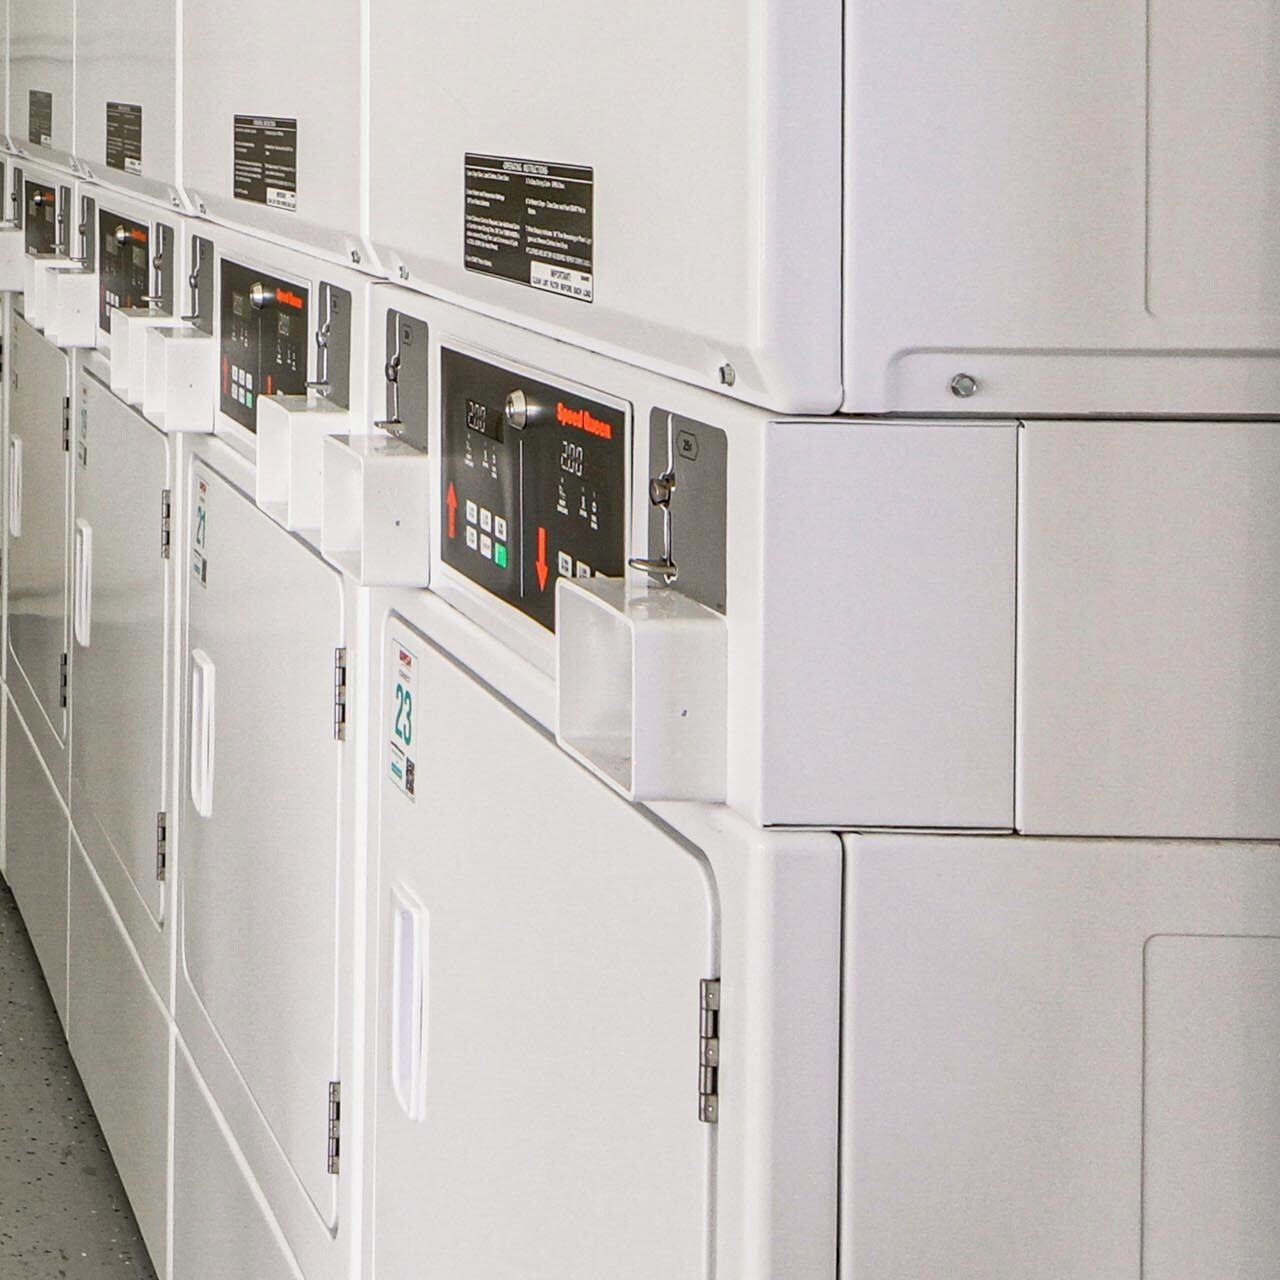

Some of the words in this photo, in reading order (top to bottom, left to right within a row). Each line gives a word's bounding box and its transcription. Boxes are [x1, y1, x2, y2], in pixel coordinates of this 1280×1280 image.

[556, 401, 583, 429] Speed
[583, 410, 612, 440] Queen
[196, 505, 206, 549] 21
[395, 683, 412, 746] 23
